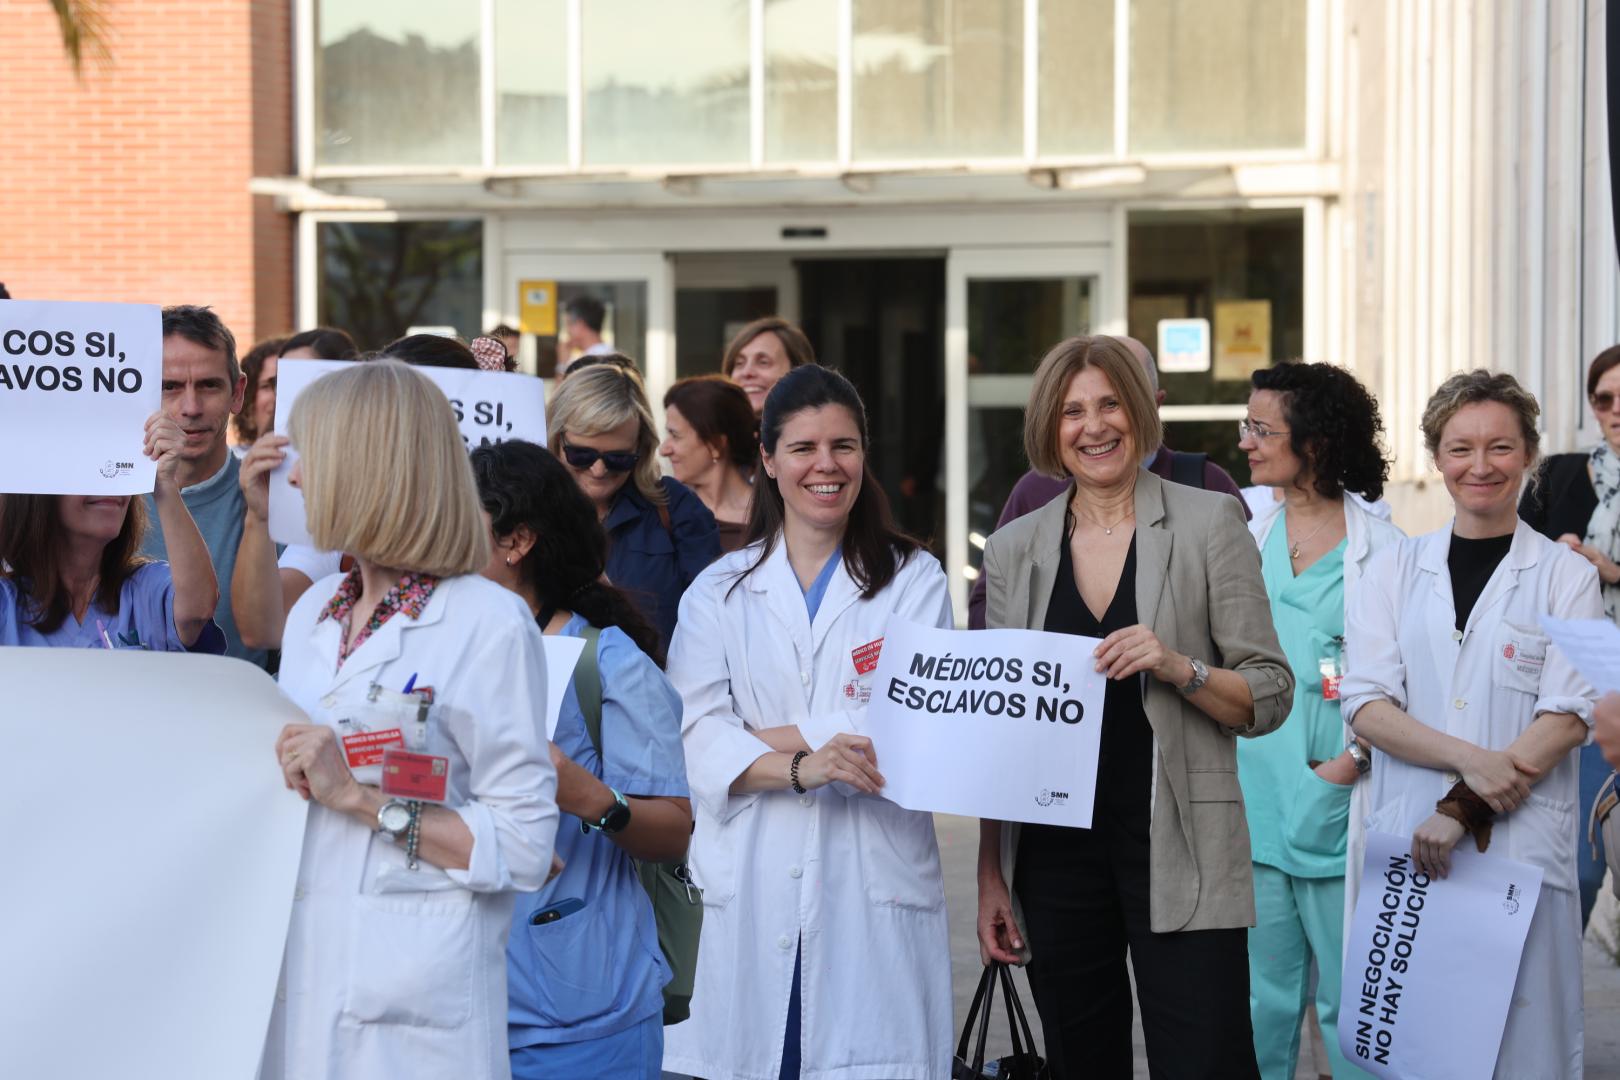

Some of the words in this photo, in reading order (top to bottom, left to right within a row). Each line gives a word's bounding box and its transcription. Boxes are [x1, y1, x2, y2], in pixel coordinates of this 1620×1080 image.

[84, 331, 126, 363] SI,
[93, 366, 143, 393] NO
[473, 401, 513, 432] SI,
[909, 652, 1023, 683] MÉDICOS
[1031, 661, 1071, 694] SI,
[887, 677, 1026, 719] ESCLAVOS
[1035, 695, 1085, 725] NO
[1050, 791, 1069, 799] SMN
[1506, 883, 1515, 900] SMN
[1359, 853, 1412, 1017] NEGOCIACIÓN,
[1390, 871, 1431, 975] SOLUCIÓ
[1379, 976, 1404, 1026] HAY
[1355, 1019, 1373, 1060] SIN
[1373, 1029, 1393, 1067] NO
